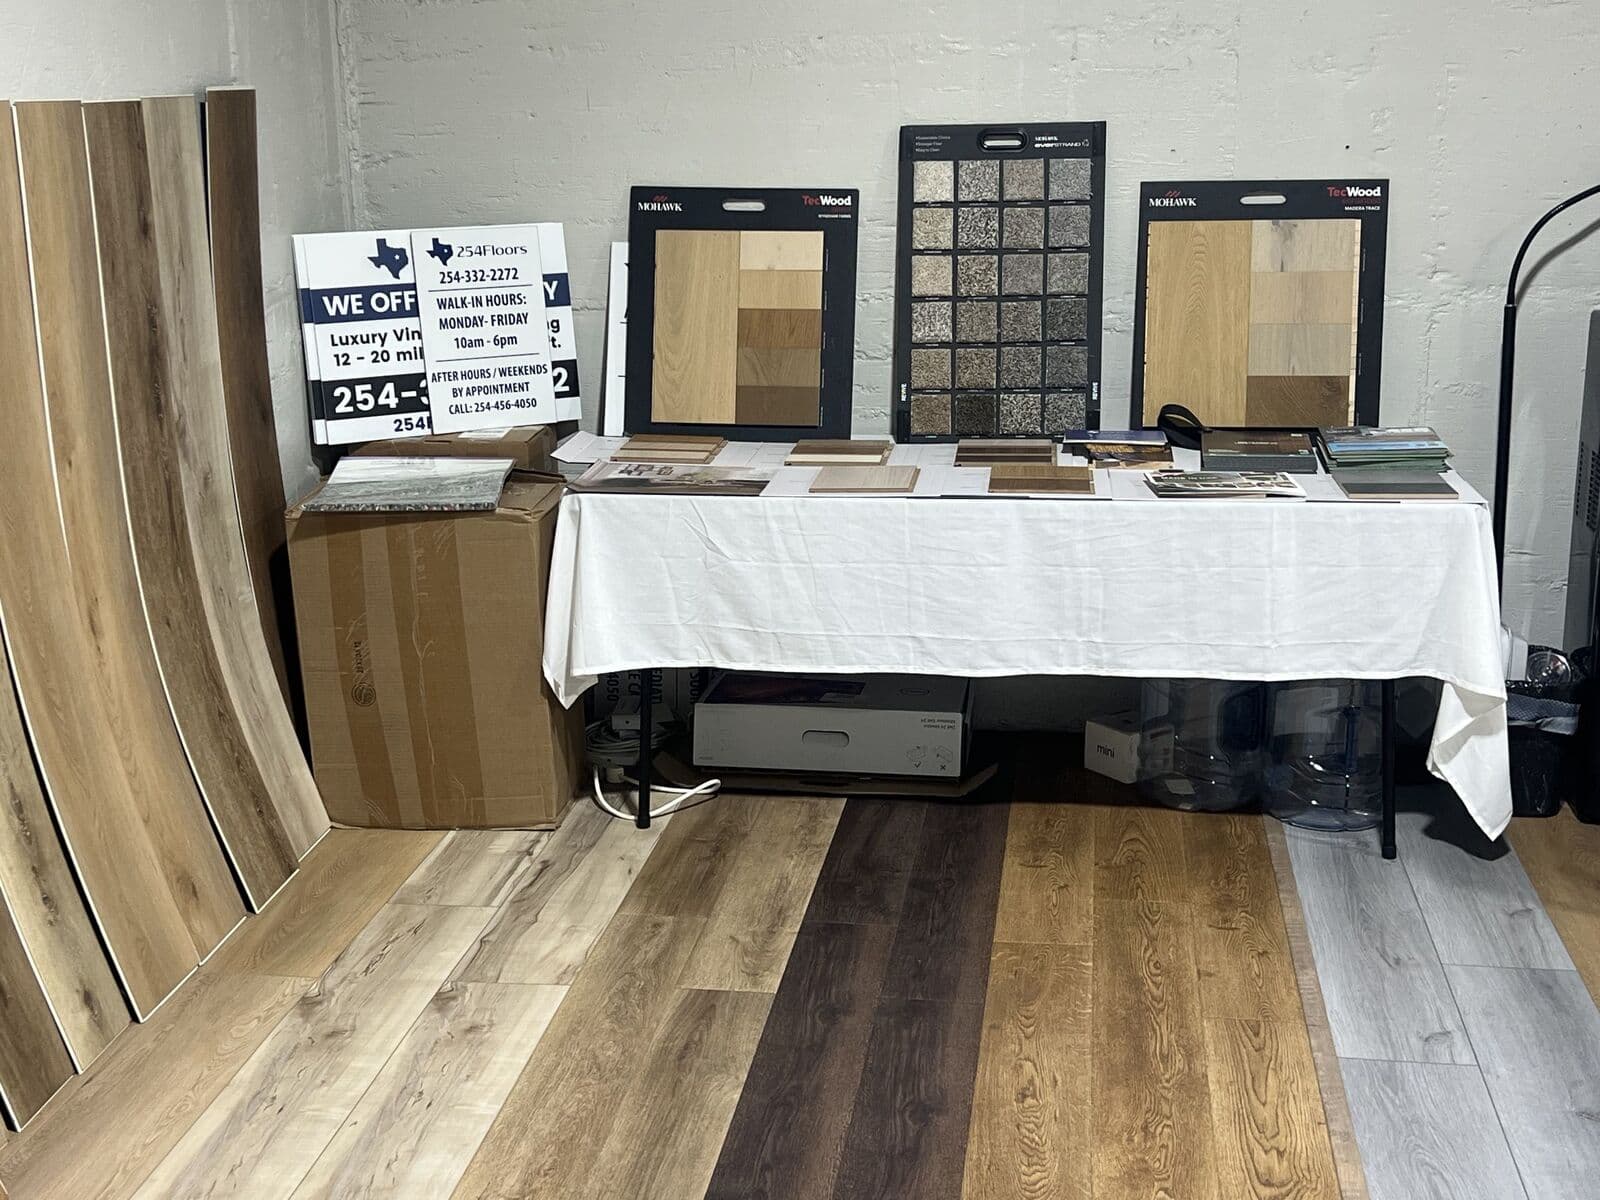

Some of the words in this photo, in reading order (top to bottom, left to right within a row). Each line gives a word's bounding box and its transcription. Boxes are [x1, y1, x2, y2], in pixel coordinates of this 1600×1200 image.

[1327, 186, 1381, 197] TecWood
[638, 202, 683, 212] MOHAWK
[802, 195, 852, 206] TecWood
[1149, 198, 1197, 207] MOHAWK
[457, 244, 528, 258] 254Floors
[439, 268, 519, 284] 254-332-2272
[322, 294, 364, 316] WE
[436, 295, 484, 311] WALK-IN
[485, 293, 527, 308] HOURS:
[439, 315, 488, 330] MONDAY-
[491, 312, 529, 327] FRIDAY
[330, 330, 388, 349] Luxury
[454, 337, 485, 350] 10am
[493, 335, 518, 349] 6pm
[334, 353, 351, 367] 12
[371, 350, 390, 364] 20
[431, 370, 459, 383] AFTER
[460, 368, 491, 381] HOURS
[498, 364, 548, 377] WEEKENDS
[452, 386, 464, 398] BY
[465, 382, 530, 398] APPOINTMENT
[448, 403, 473, 416] CALL:
[474, 398, 537, 414] 254-456-4050
[1096, 742, 1116, 758] mini
